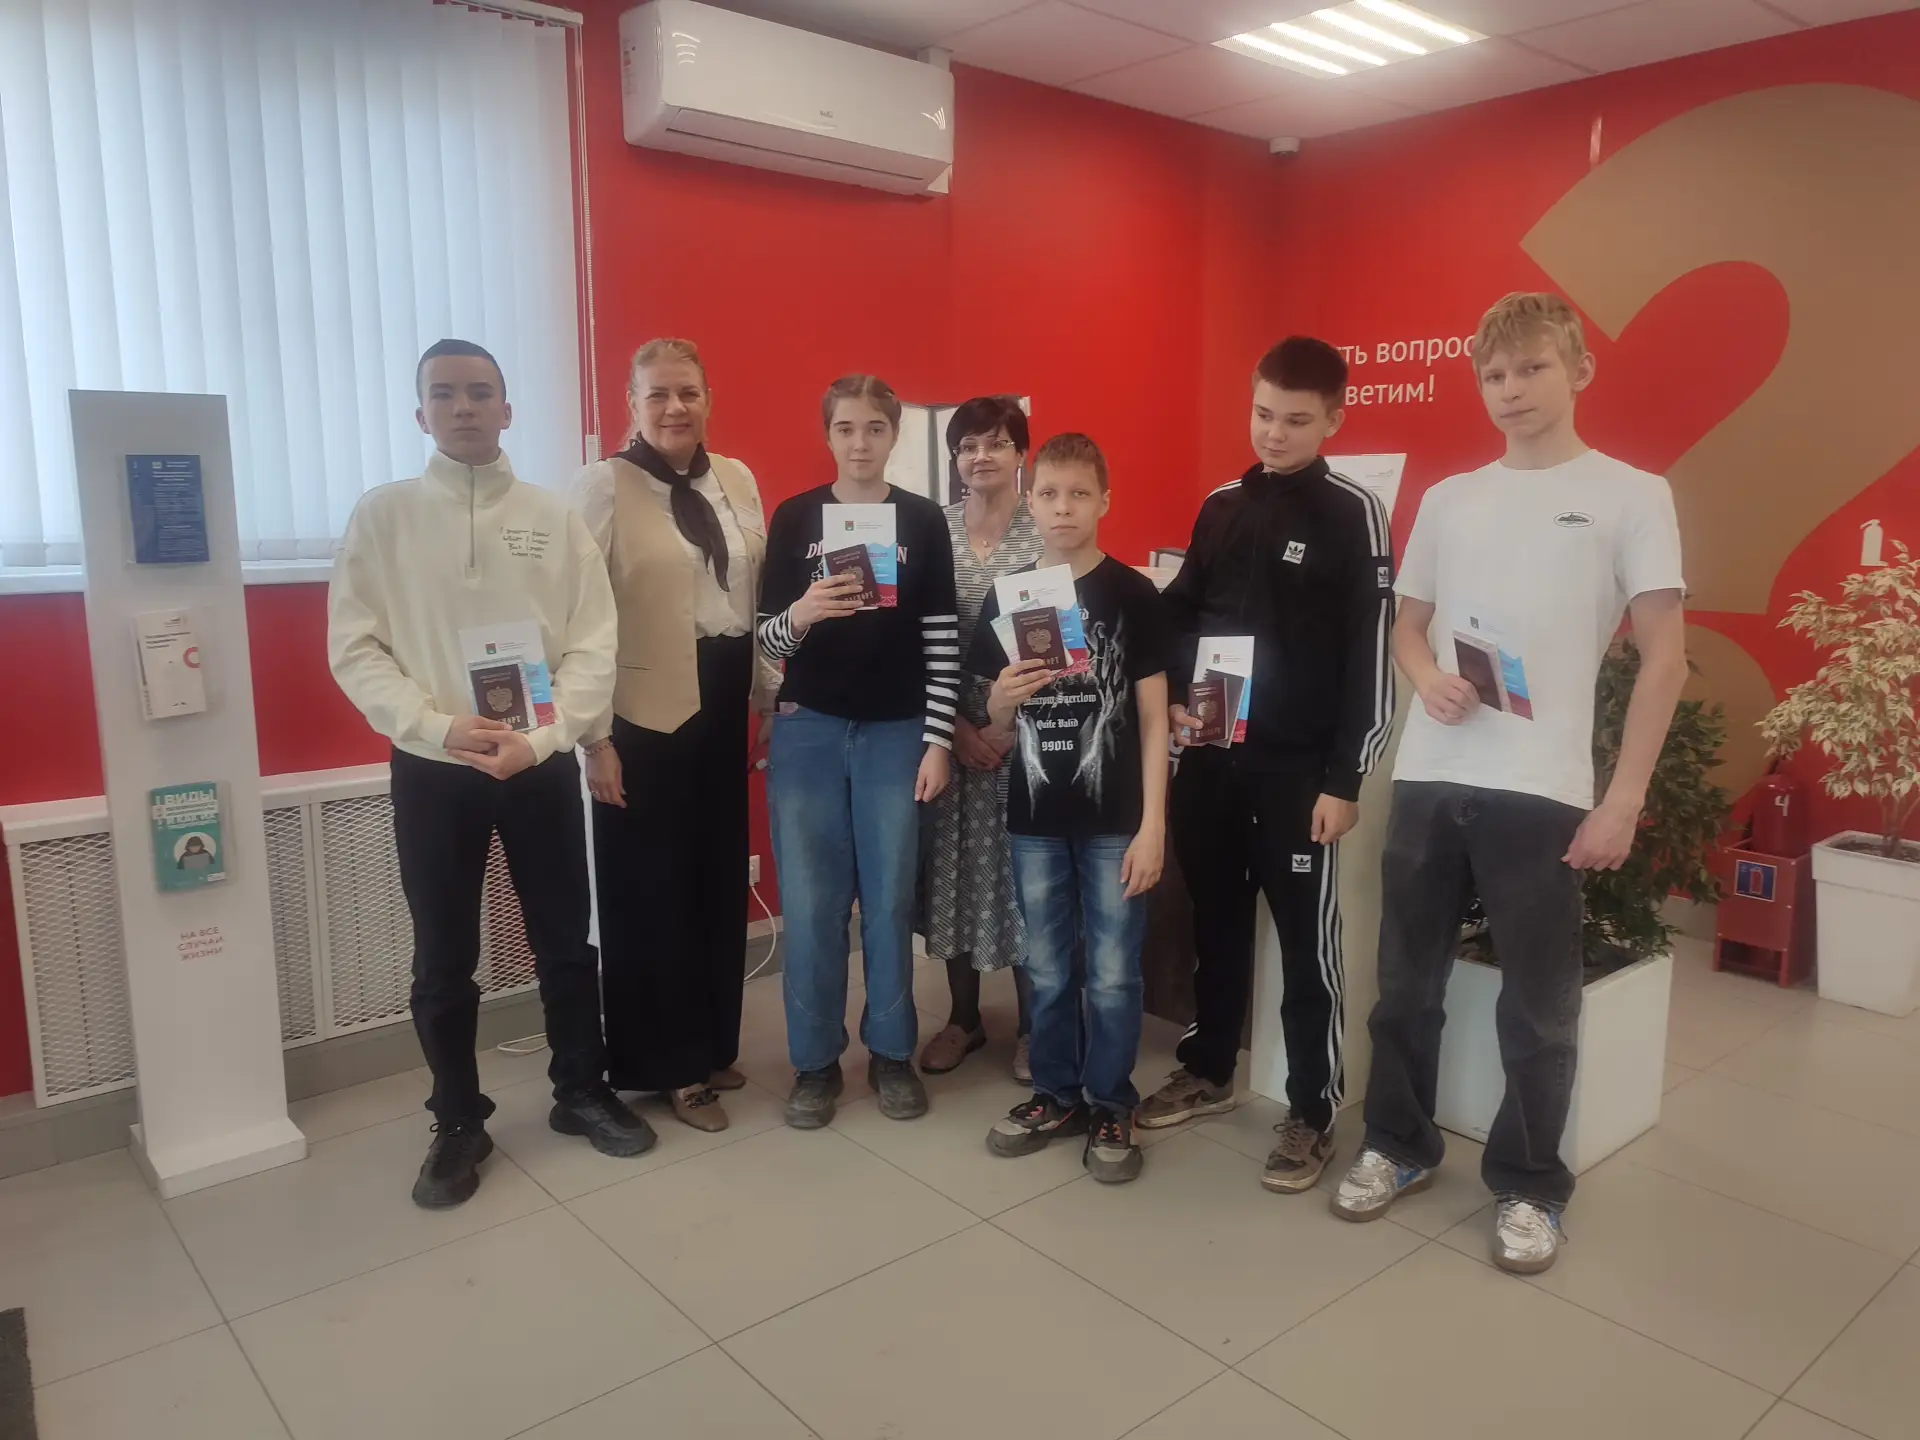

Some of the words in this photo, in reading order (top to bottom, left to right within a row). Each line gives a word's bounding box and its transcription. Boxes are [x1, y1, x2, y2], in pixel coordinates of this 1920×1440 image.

[1337, 345, 1368, 365] ть
[1345, 374, 1434, 406] ветим!
[164, 789, 215, 805] ВИДЫ
[1774, 794, 1791, 817] 4
[180, 931, 197, 940] НА
[199, 926, 220, 936] ВСЕ
[180, 947, 222, 961] ЖИЗНИ
